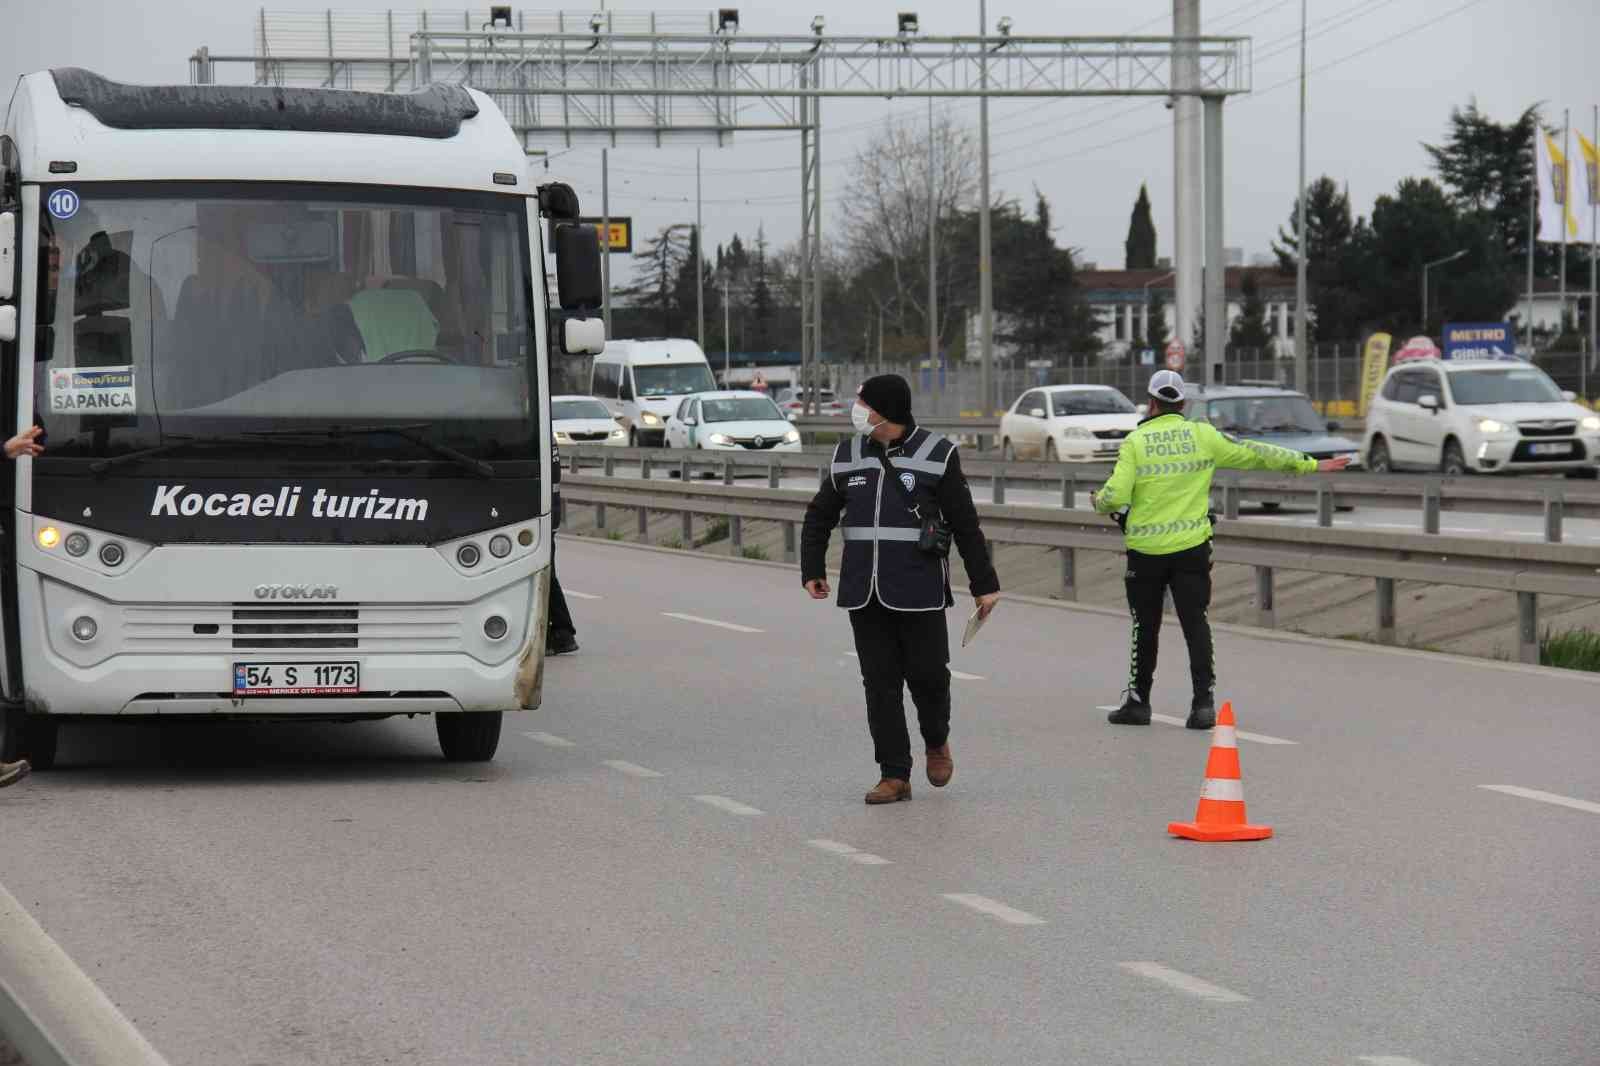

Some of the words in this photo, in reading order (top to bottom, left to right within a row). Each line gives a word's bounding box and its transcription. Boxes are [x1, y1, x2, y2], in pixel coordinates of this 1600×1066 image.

[52, 194, 73, 213] 10
[1450, 328, 1505, 341] METRO
[54, 393, 133, 410] SAPANCA
[1143, 430, 1192, 444] TRAFİK
[150, 485, 302, 518] Kocaeli
[311, 488, 429, 521] turizm
[253, 583, 337, 600] OTOKAR
[247, 667, 272, 686] 54
[285, 666, 298, 686] S
[314, 666, 356, 686] 1173
